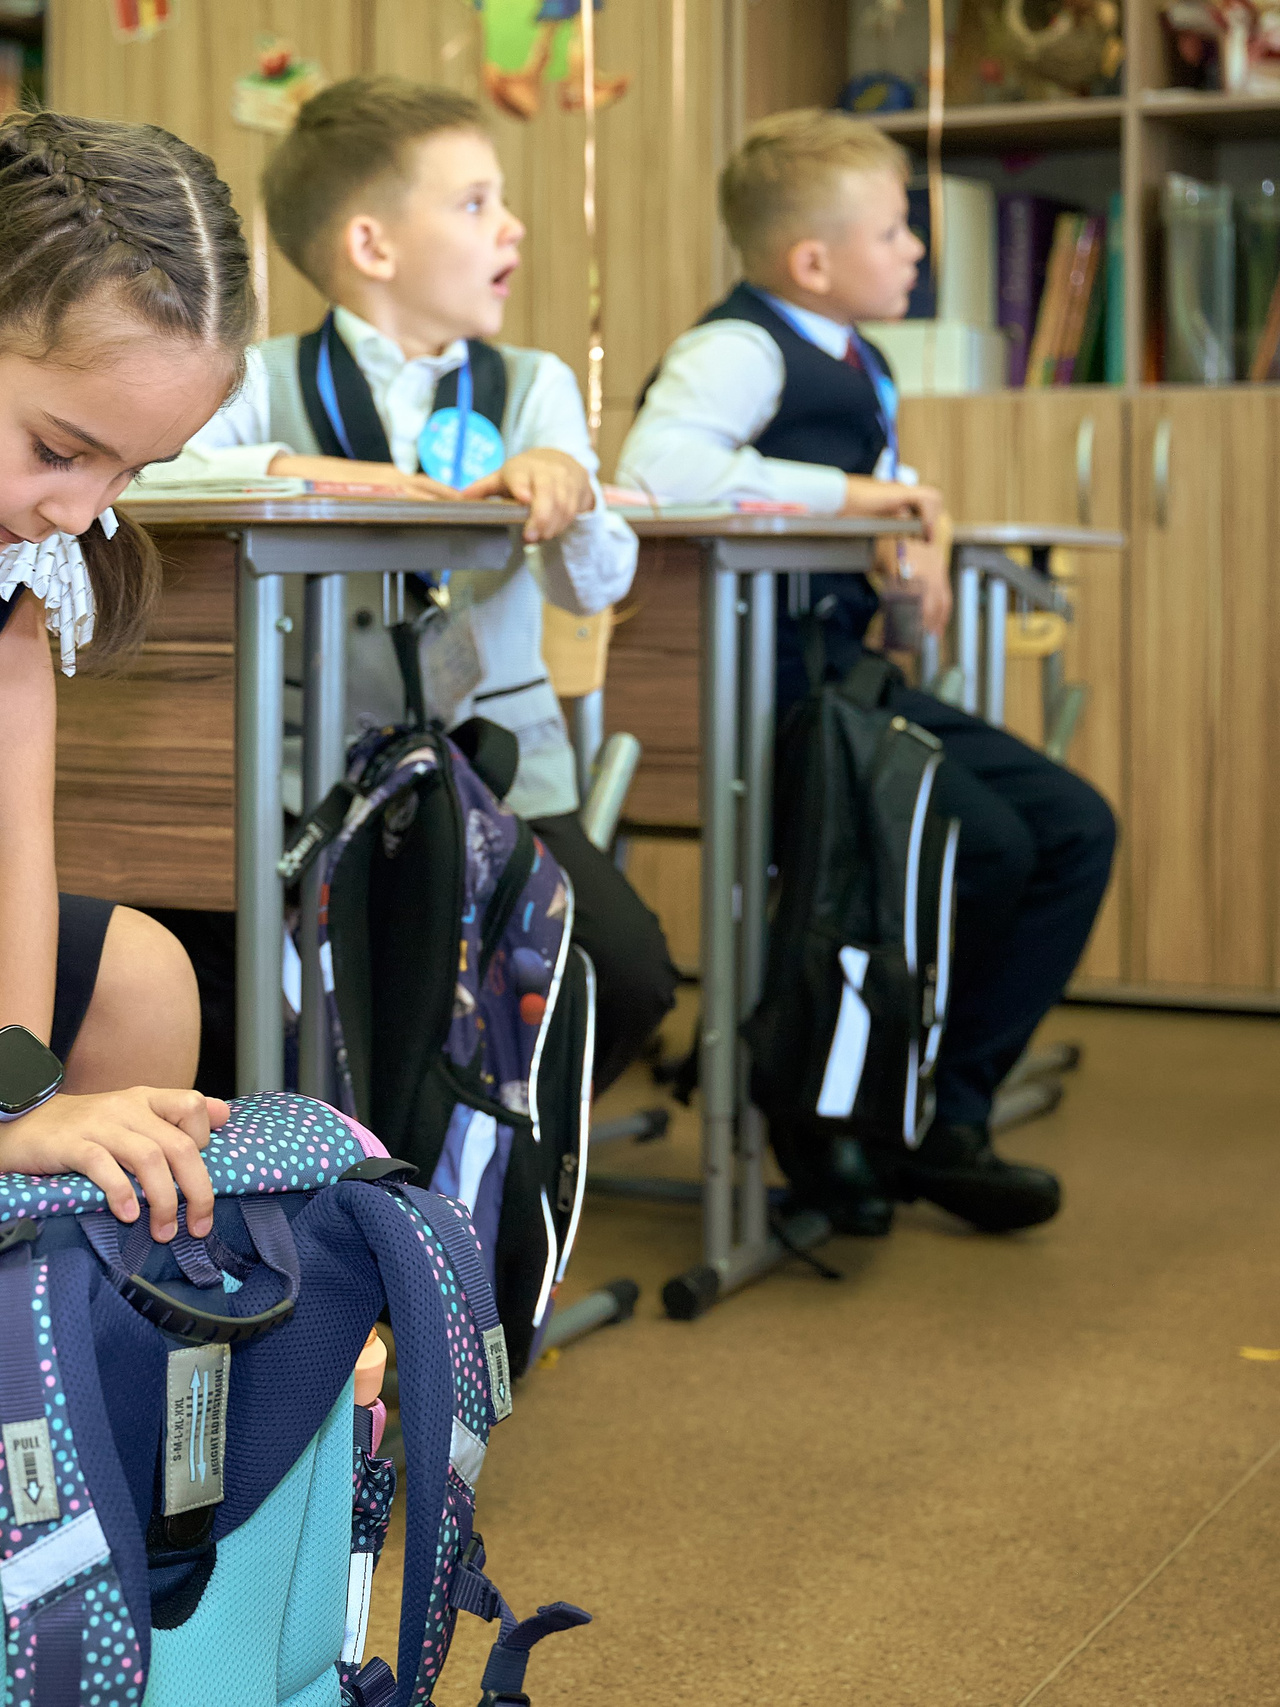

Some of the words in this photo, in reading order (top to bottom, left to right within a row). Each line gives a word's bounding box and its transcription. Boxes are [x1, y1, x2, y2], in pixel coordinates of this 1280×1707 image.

[490, 1341, 503, 1356] PULL
[211, 1368, 223, 1434] ADJUSTMENT
[13, 1436, 40, 1451] PULL
[211, 1437, 220, 1475] HEIGHT
